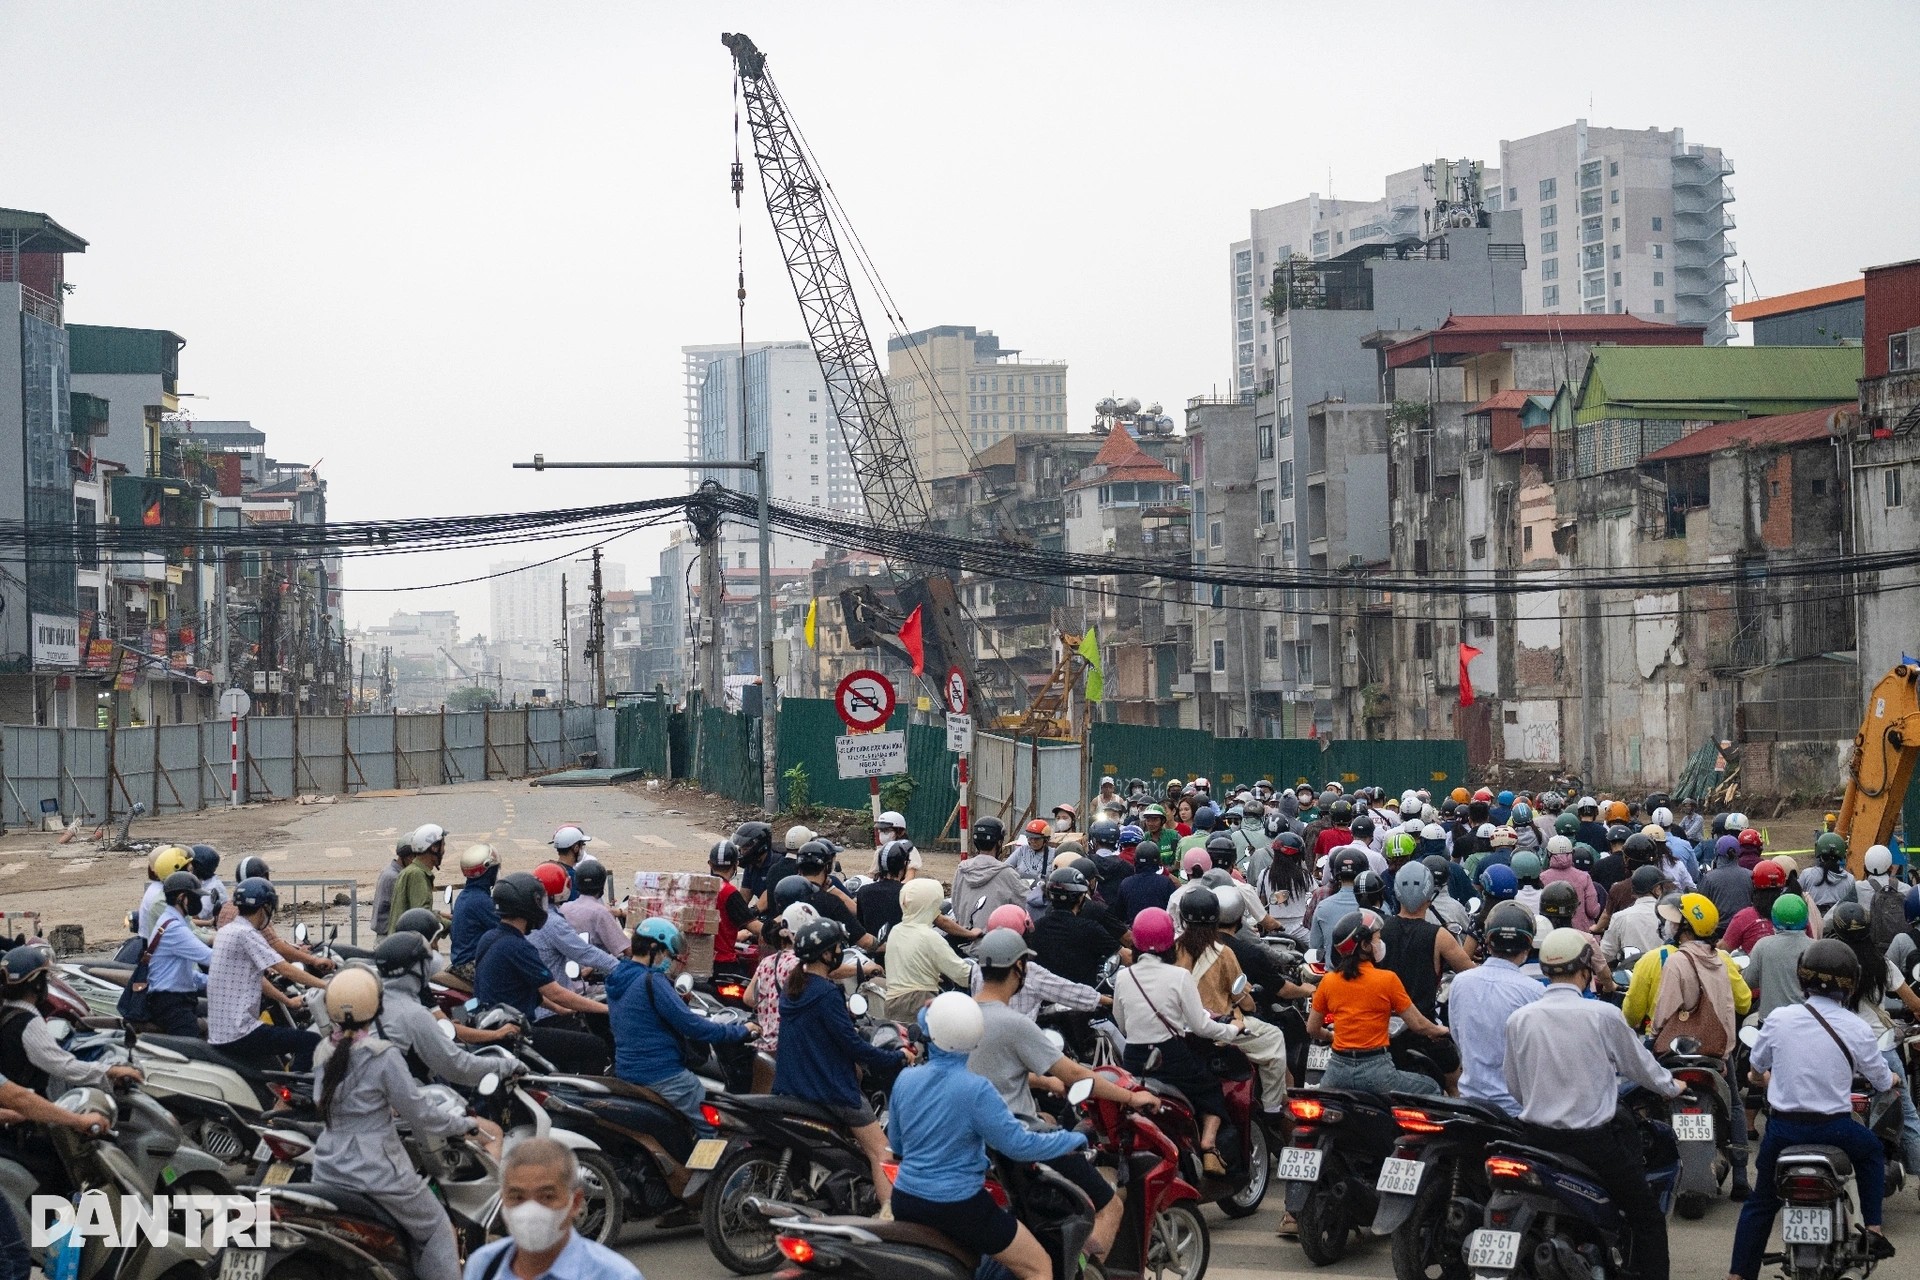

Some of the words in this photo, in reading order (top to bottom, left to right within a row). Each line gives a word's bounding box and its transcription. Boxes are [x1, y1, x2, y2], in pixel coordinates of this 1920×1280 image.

[1678, 1115, 1707, 1127] 36-AE
[1676, 1127, 1711, 1139] 315.59
[1286, 1150, 1316, 1165] 29-P2
[1280, 1163, 1317, 1179] 029.58
[1388, 1161, 1417, 1177] 29-V5
[1380, 1175, 1416, 1192] 708.66
[1789, 1209, 1823, 1225] 29-P1
[1479, 1233, 1512, 1250] 99-G1
[1785, 1226, 1828, 1241] 246.59
[230, 1252, 258, 1271] 18-K1
[1472, 1249, 1513, 1266] 697.28
